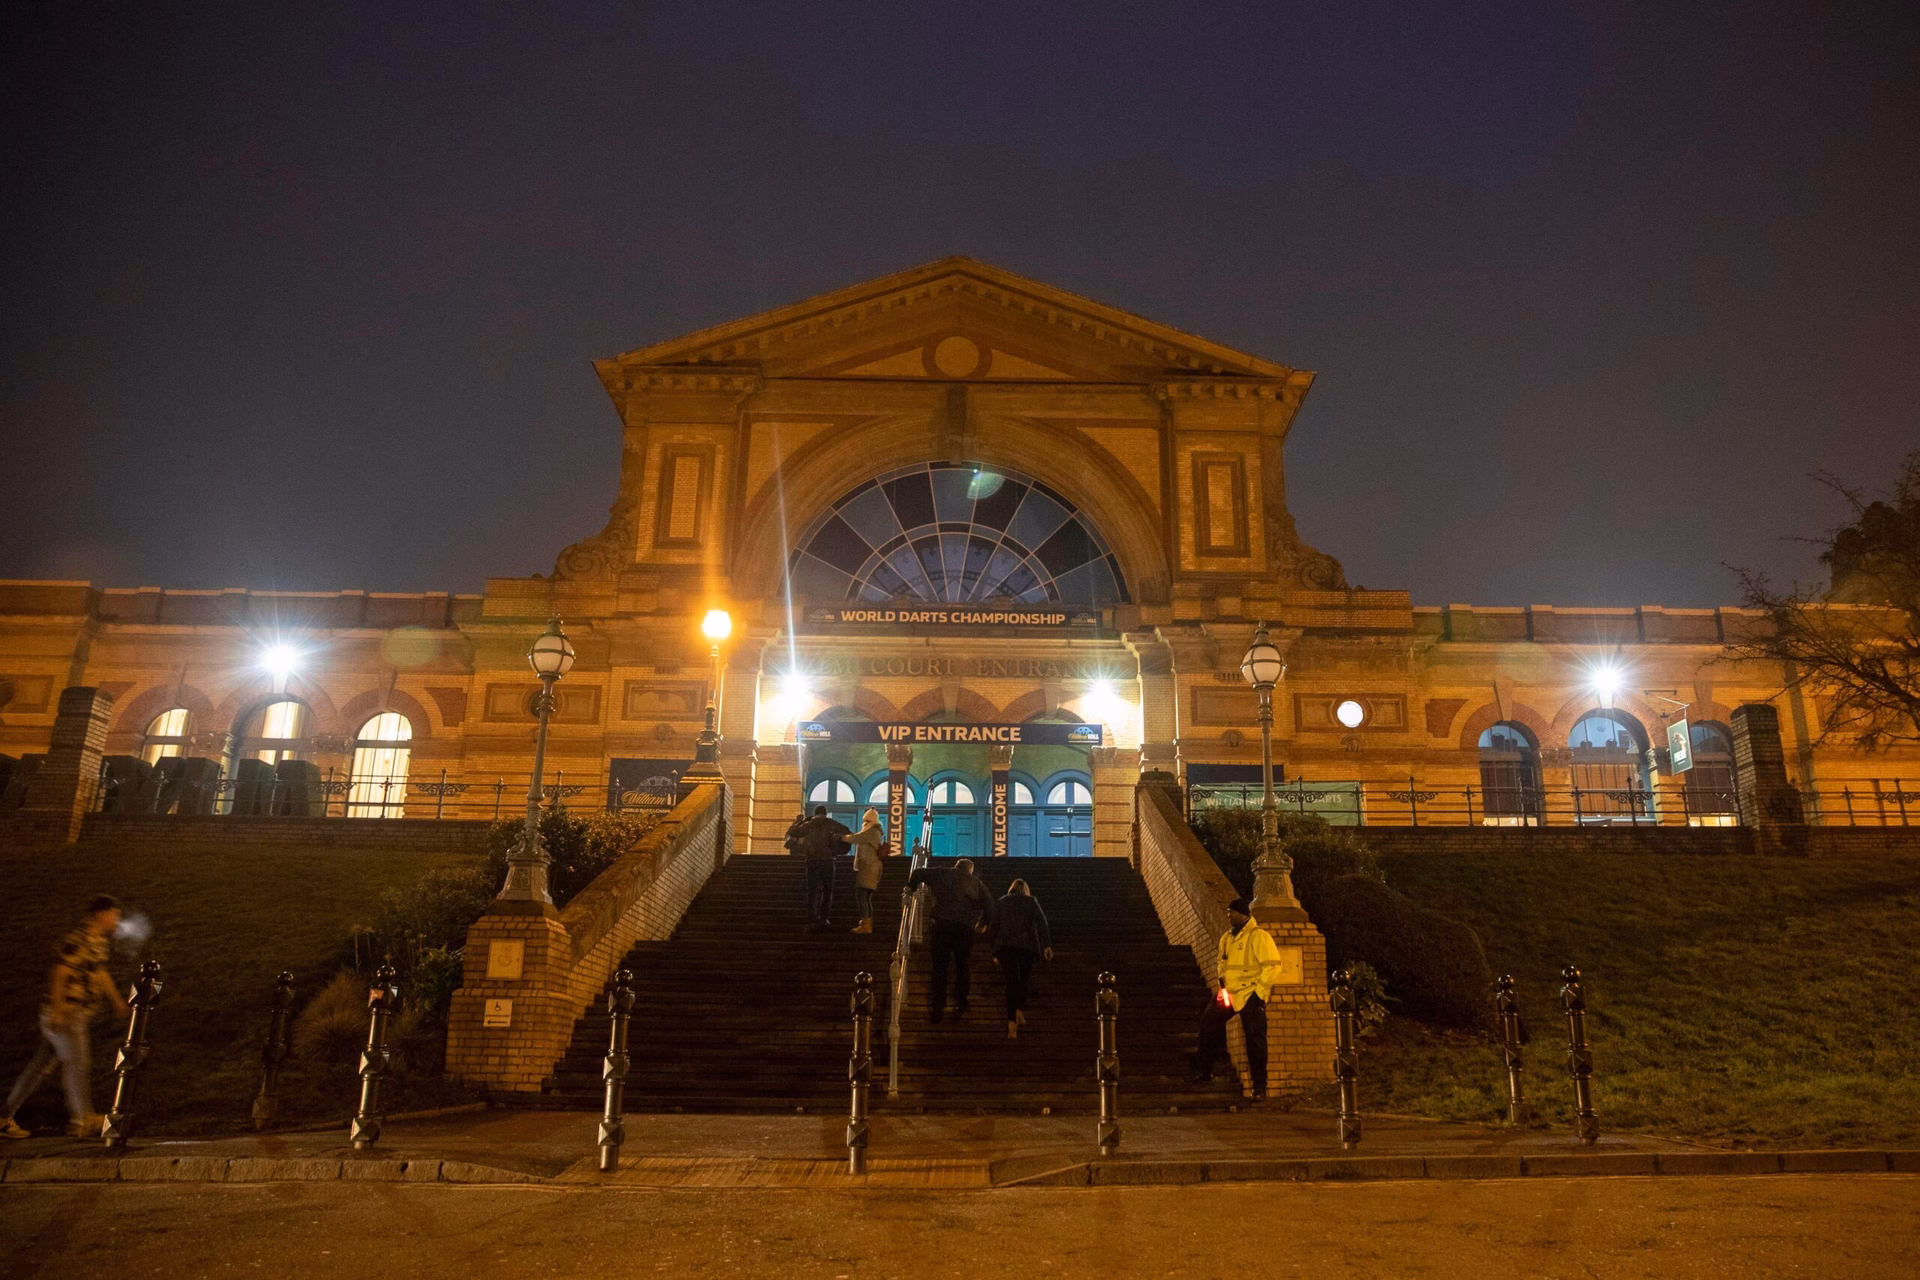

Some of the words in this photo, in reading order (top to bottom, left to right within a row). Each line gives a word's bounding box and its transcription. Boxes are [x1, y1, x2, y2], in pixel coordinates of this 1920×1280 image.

[841, 610, 896, 622] WORLD
[899, 611, 948, 623] DARTS
[951, 612, 1066, 625] CHAMPIONSHIP
[870, 656, 957, 676] COURT
[878, 725, 912, 740] VIP
[915, 726, 1022, 741] ENTRANCE
[890, 783, 903, 857] WELCOME
[994, 783, 1007, 857] WELCOME
